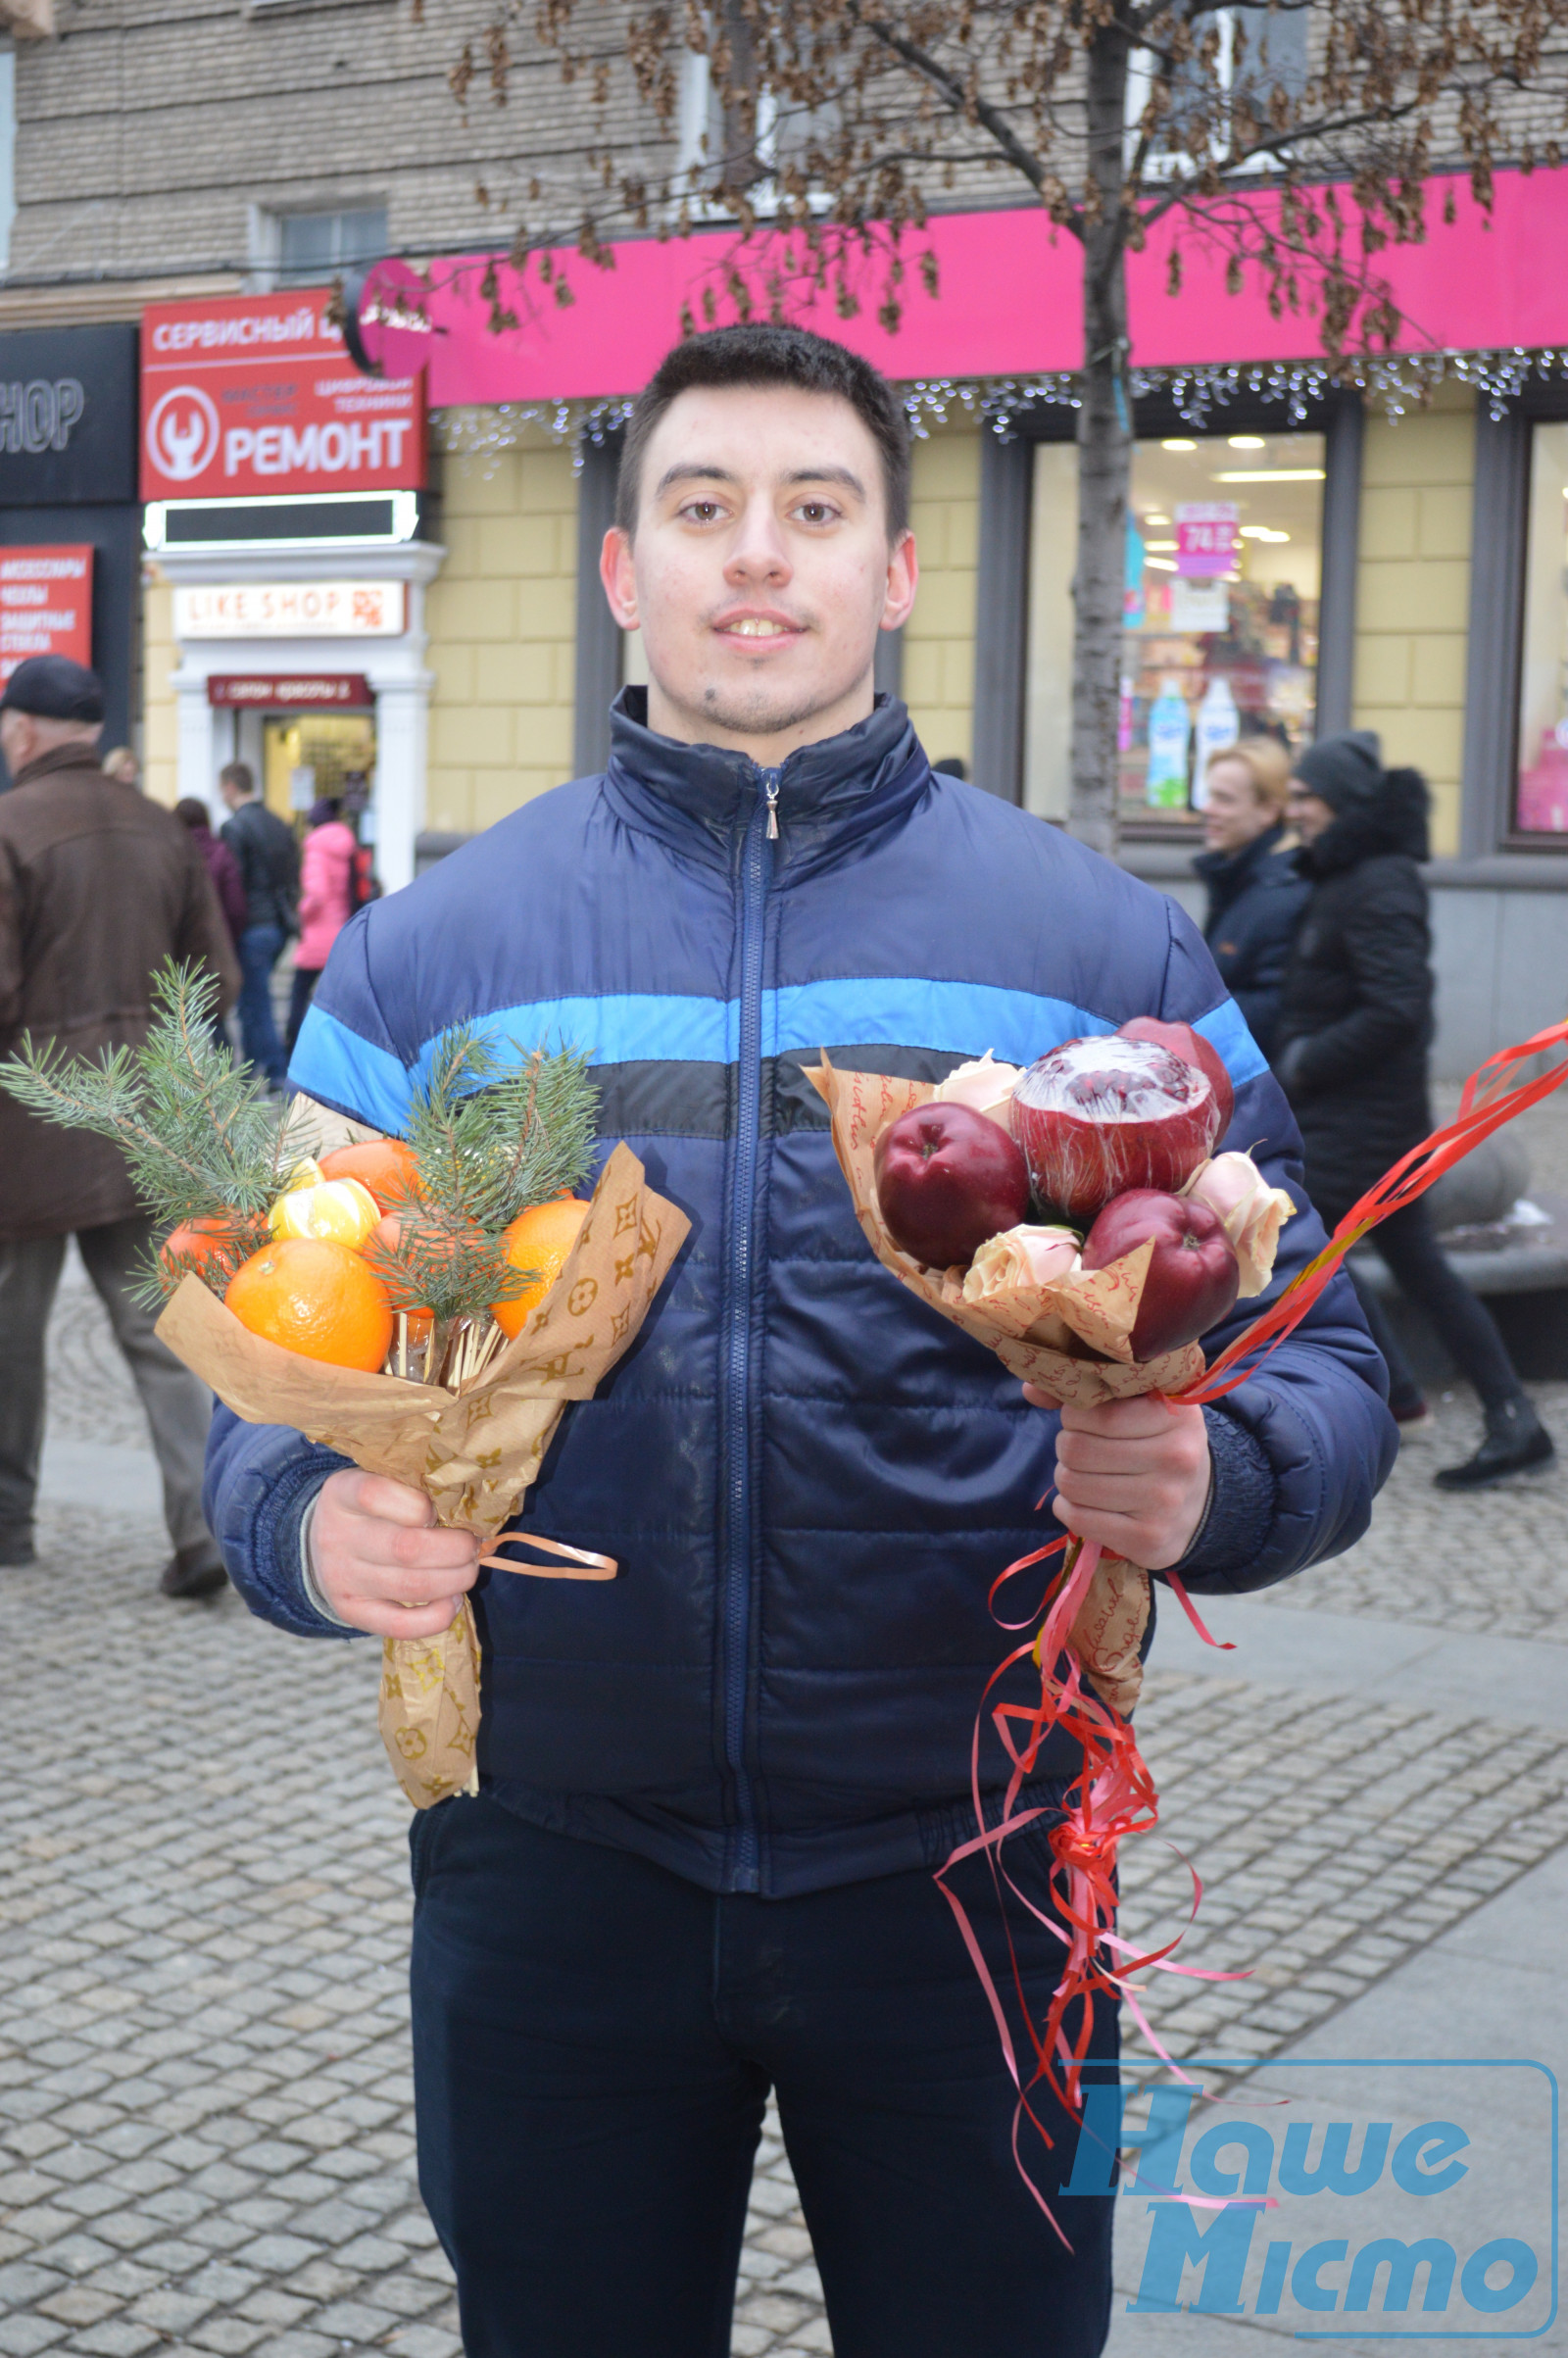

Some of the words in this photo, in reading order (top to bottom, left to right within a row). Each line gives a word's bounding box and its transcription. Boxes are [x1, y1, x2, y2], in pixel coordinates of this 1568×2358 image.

[152, 307, 315, 351] СЕРВИСНЫЙ
[224, 418, 413, 477] РЕМОНТ
[189, 592, 247, 620] LIKE
[261, 591, 339, 619] SHOP
